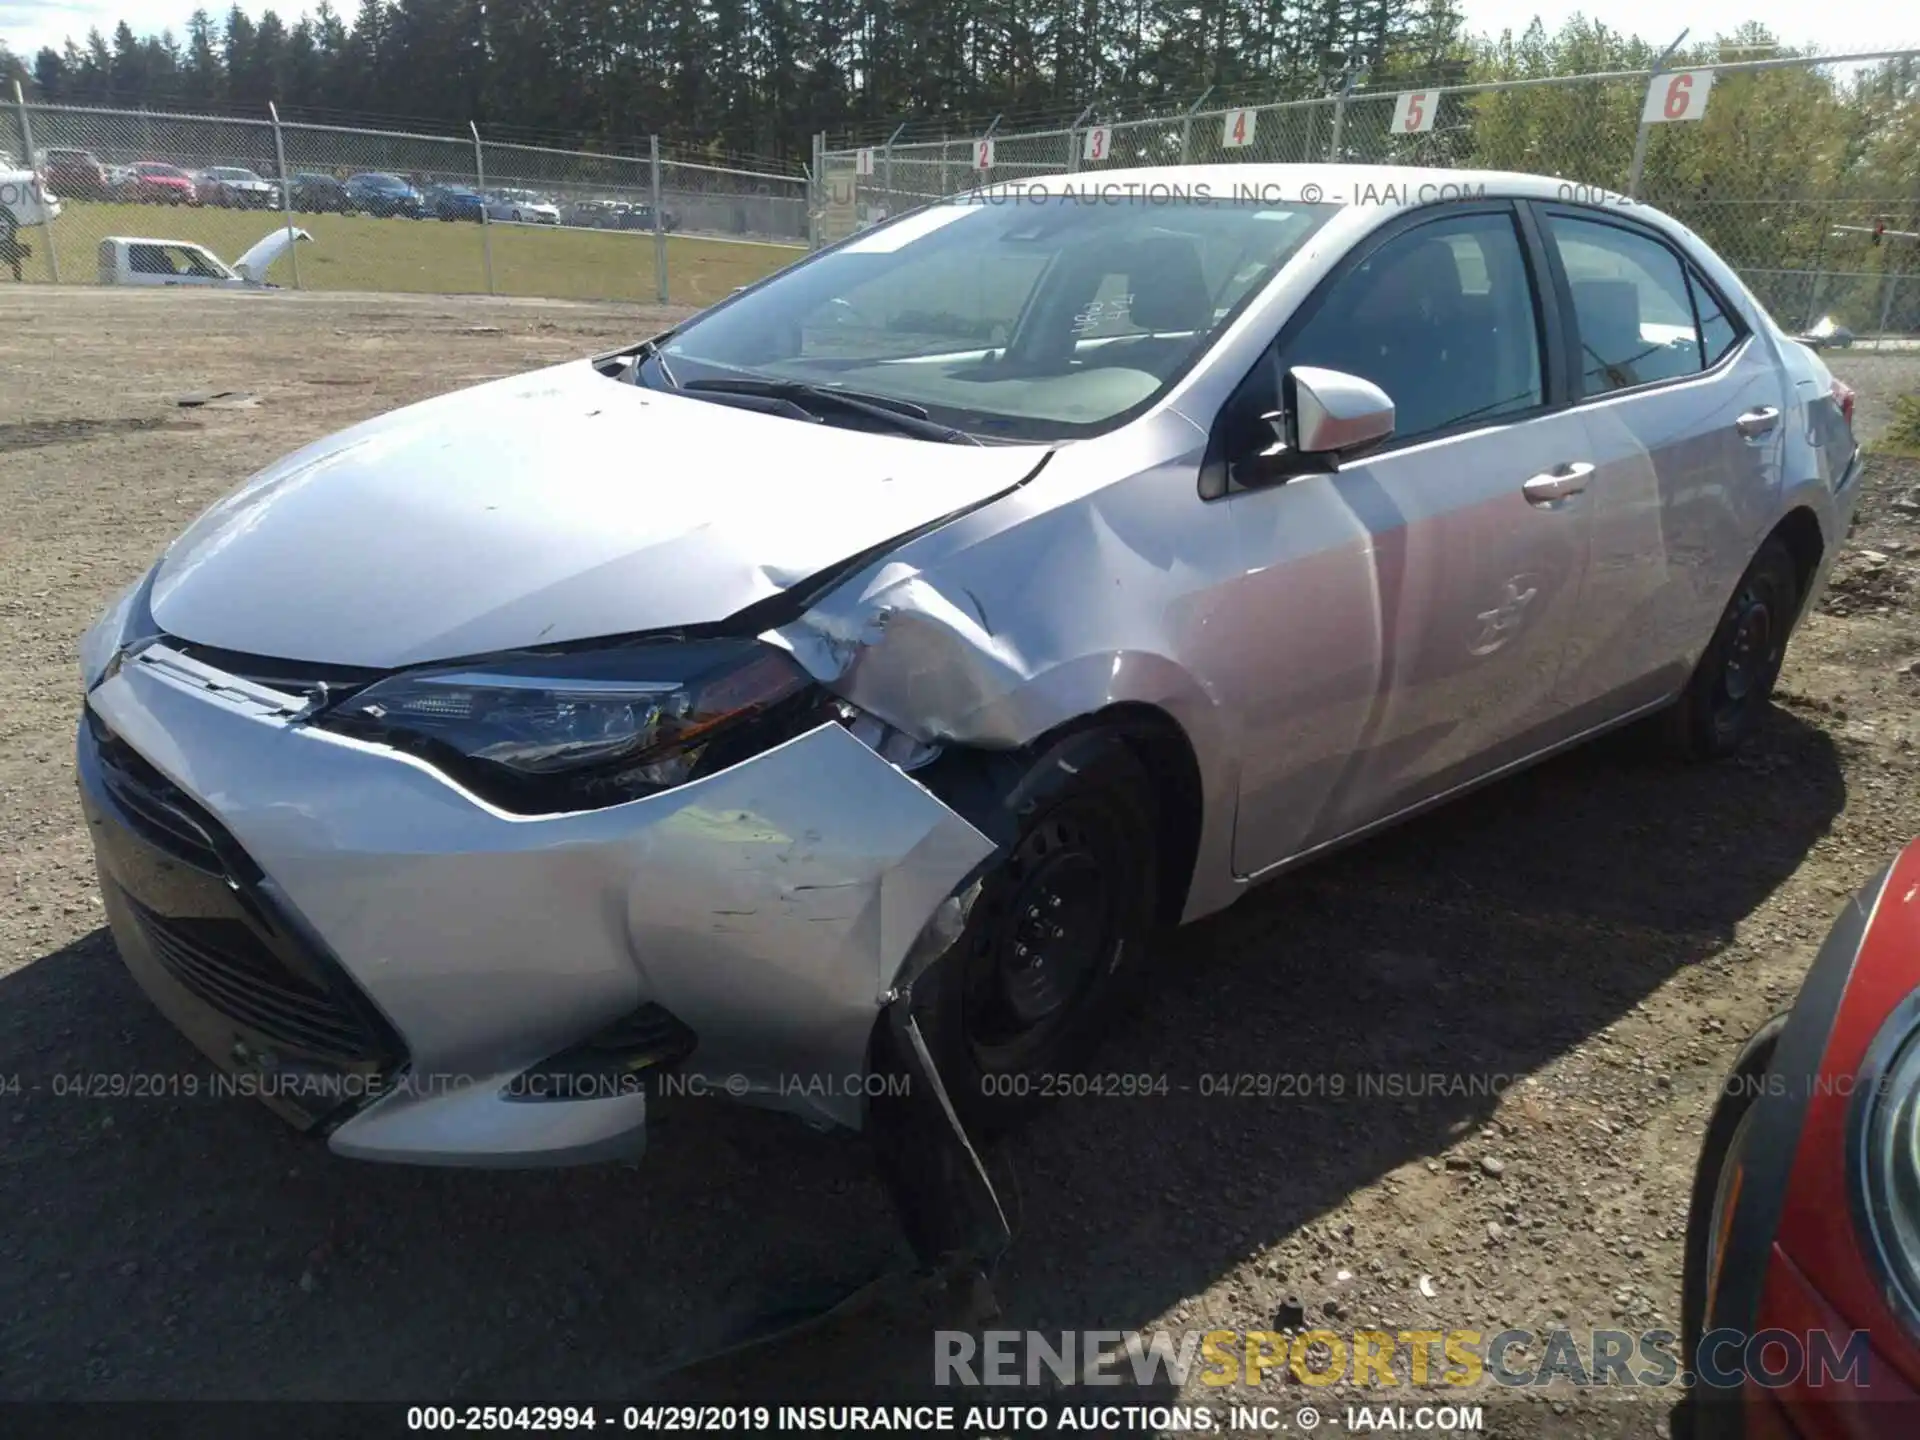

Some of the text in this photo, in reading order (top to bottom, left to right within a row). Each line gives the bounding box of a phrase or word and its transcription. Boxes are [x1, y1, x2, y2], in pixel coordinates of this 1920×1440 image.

[1663, 73, 1693, 120] 6
[1232, 111, 1246, 145] 4
[1404, 95, 1426, 132] 5
[979, 142, 990, 168] 2
[1091, 130, 1104, 158] 3
[860, 152, 868, 173] 1
